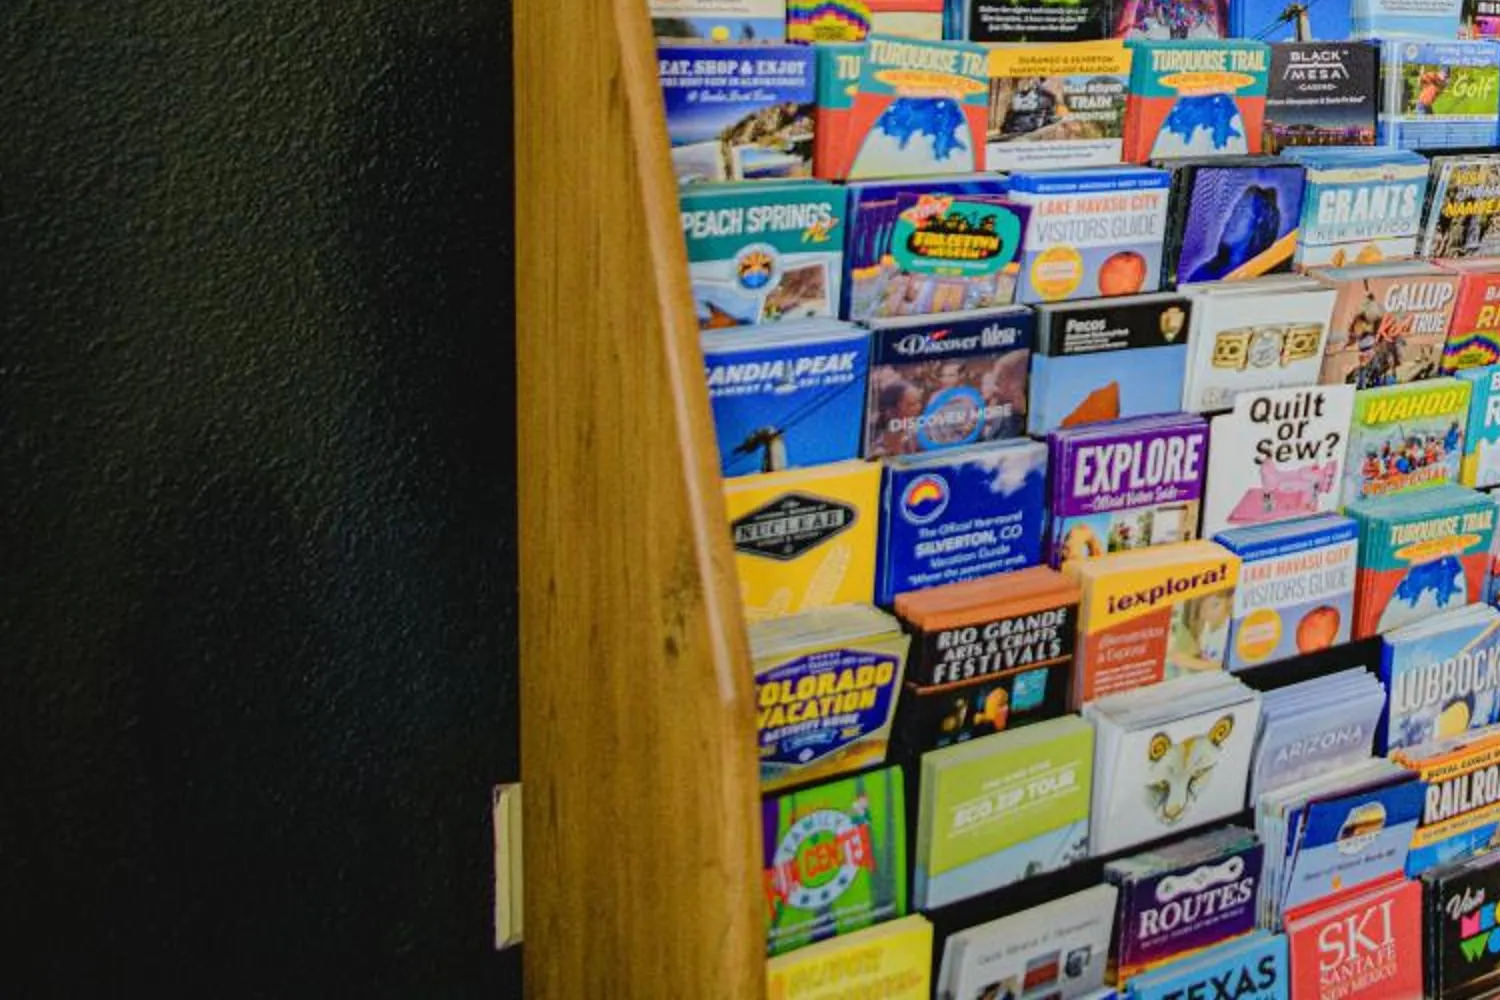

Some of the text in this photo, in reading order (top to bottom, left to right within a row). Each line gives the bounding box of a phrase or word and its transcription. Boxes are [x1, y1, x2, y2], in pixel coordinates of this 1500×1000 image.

[694, 60, 737, 75] SHOP
[740, 61, 753, 75] &
[756, 60, 806, 75] ENJOY
[868, 41, 960, 72] TURQUOISE
[962, 51, 990, 75] TRA
[1152, 49, 1267, 73] TURQUOISE TRAIL
[1289, 50, 1341, 63] BLACK
[1291, 69, 1342, 81] MESA
[1453, 72, 1495, 101] Golf
[1070, 95, 1112, 108] TRAIN
[1037, 195, 1160, 217] LAKE HAVASU CITY
[1317, 186, 1417, 223] GRANTS
[683, 207, 745, 239] PEACH
[1036, 213, 1158, 243] VISITORS GUIDE
[1315, 221, 1412, 242] NEW MEXICO
[1384, 282, 1453, 313] GALLUP
[1066, 318, 1107, 333] Pecos
[1412, 315, 1446, 334] TRUE
[899, 334, 978, 355] Discover
[706, 352, 859, 386] ANDIA PEAK
[888, 408, 969, 432] DISCOVER
[1250, 391, 1325, 423] Quilt
[1366, 391, 1467, 424] WAHOO!
[1277, 421, 1308, 441] or
[1254, 431, 1341, 466] Sew?
[1073, 434, 1203, 497] EXPLORE
[736, 508, 846, 543] NUCLEAR
[915, 524, 1023, 558] SILVERTON, CO
[918, 526, 936, 539] The
[938, 519, 972, 537] Official
[930, 545, 1011, 570] Vacation Guide
[1275, 554, 1324, 577] HAVASU
[1325, 548, 1349, 568] CITY
[1307, 566, 1349, 595] GUIDE
[936, 608, 1068, 651] RIO GRANDE
[944, 640, 985, 661] ARTS
[1000, 625, 1058, 650] CRAFTS
[933, 639, 1063, 684] FESTIVALS
[756, 662, 895, 706] OLORADO
[1277, 725, 1364, 758] ARIZONA
[1137, 877, 1254, 939] ROUTES
[1317, 899, 1395, 972] SKI
[1162, 954, 1277, 1000] TEXAS
[1320, 942, 1396, 986] SANTA FE
[1321, 963, 1398, 1000] NEW MEXICO
